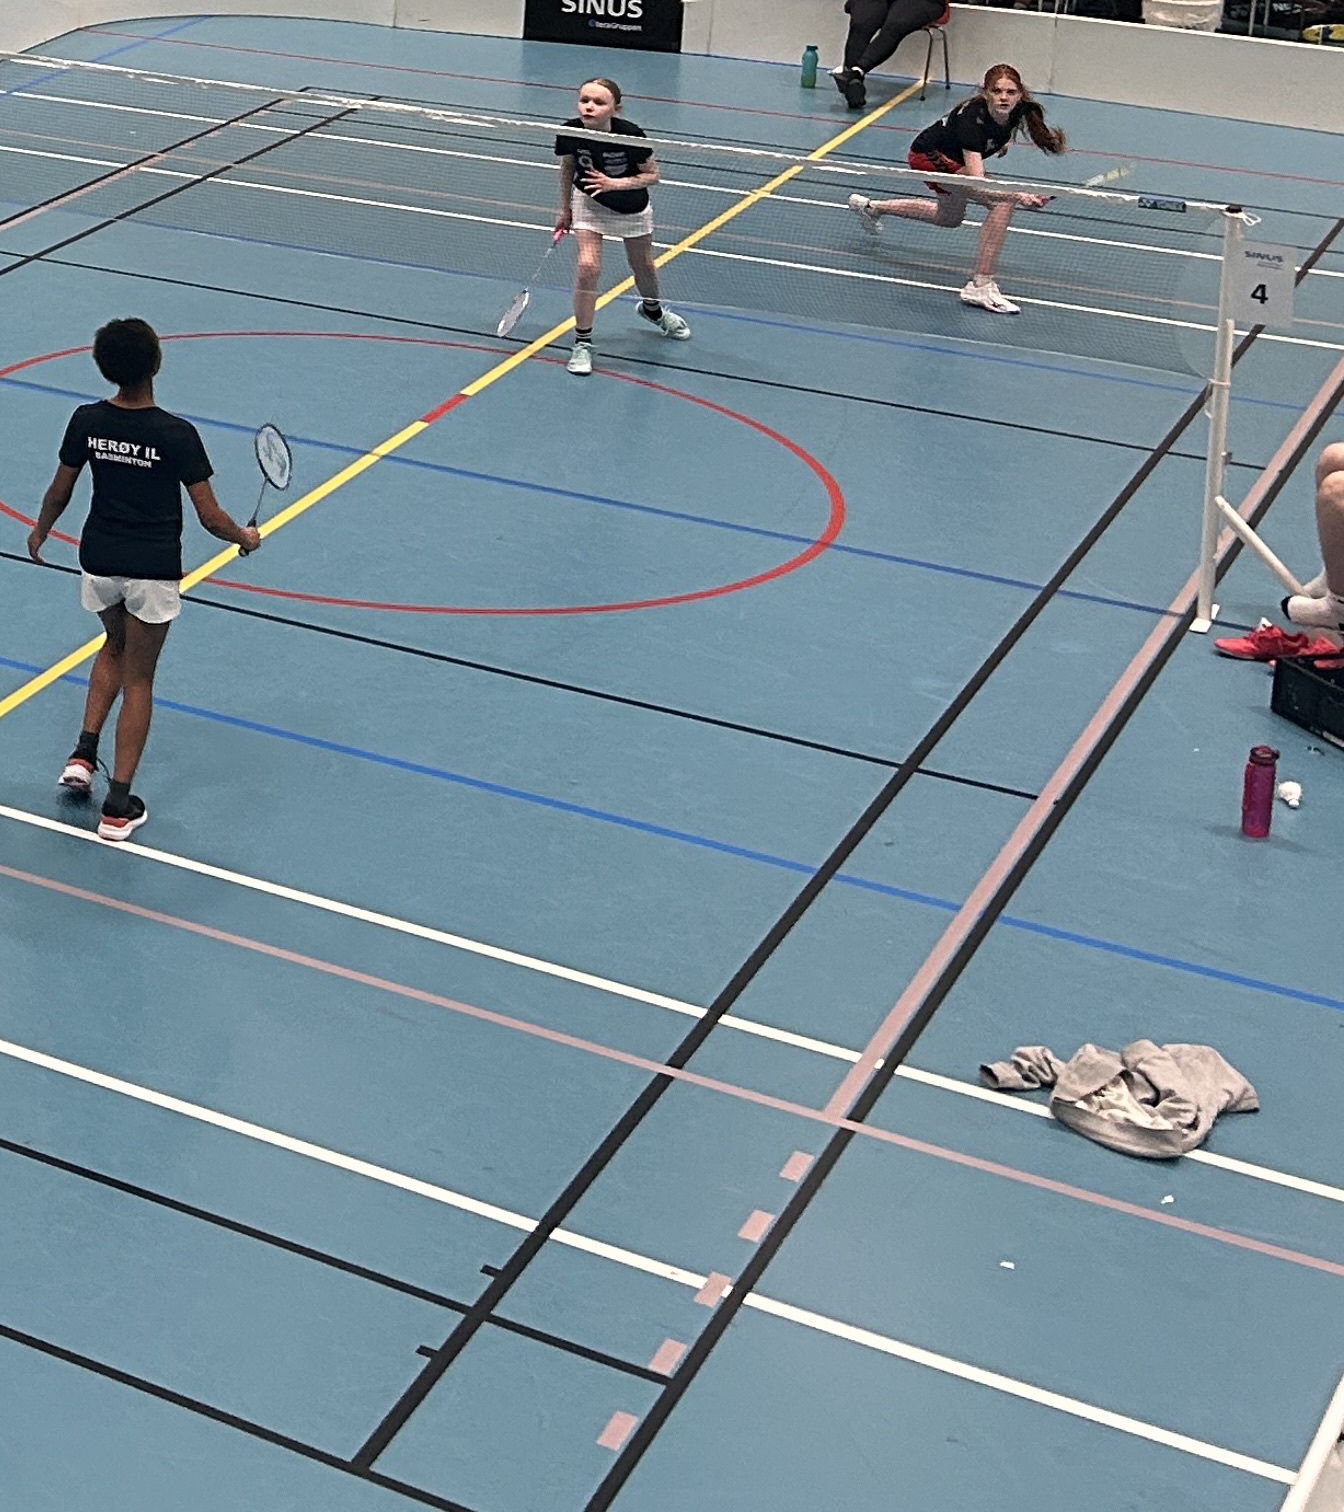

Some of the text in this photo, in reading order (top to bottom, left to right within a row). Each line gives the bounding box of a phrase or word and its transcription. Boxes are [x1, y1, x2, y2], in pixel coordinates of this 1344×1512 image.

[1250, 283, 1269, 305] 4
[87, 435, 161, 461] HERØY IL
